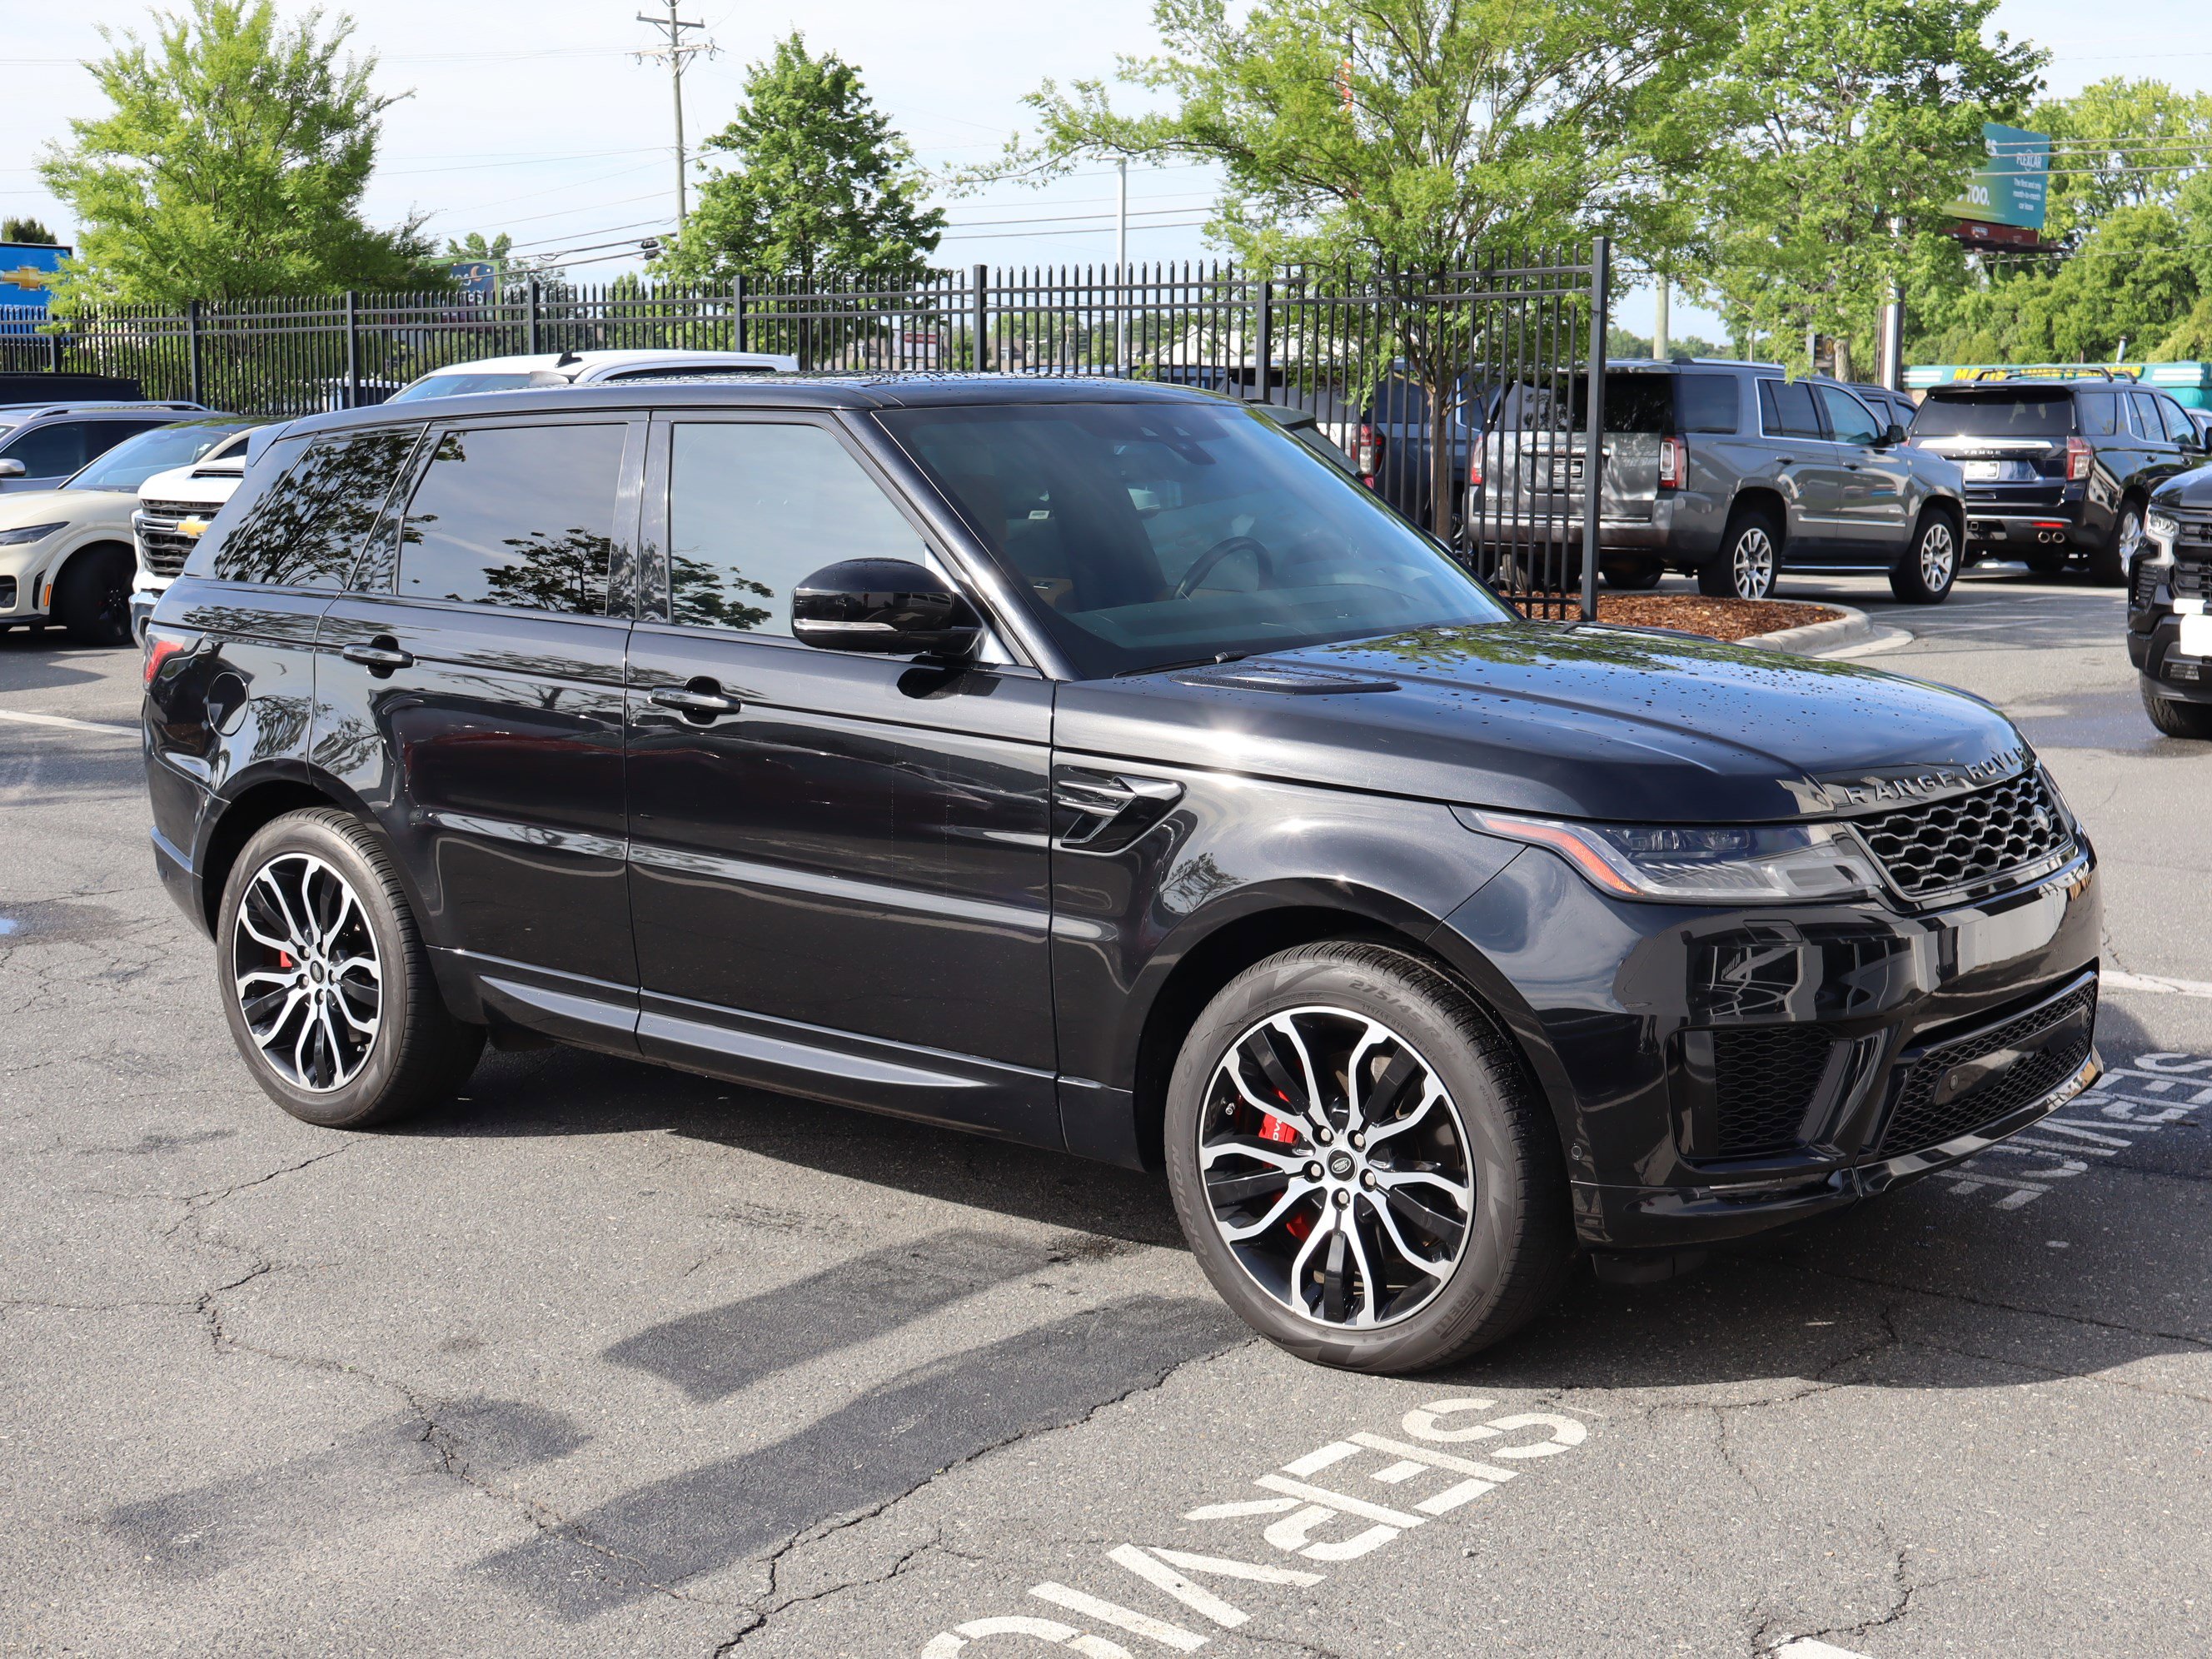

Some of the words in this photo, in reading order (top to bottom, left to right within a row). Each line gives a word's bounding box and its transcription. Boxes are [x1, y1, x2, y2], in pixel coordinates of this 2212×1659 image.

[2016, 152, 2042, 169] FLEXCAR
[1844, 770, 1956, 805] RANGE
[1965, 746, 2028, 780] ROVER
